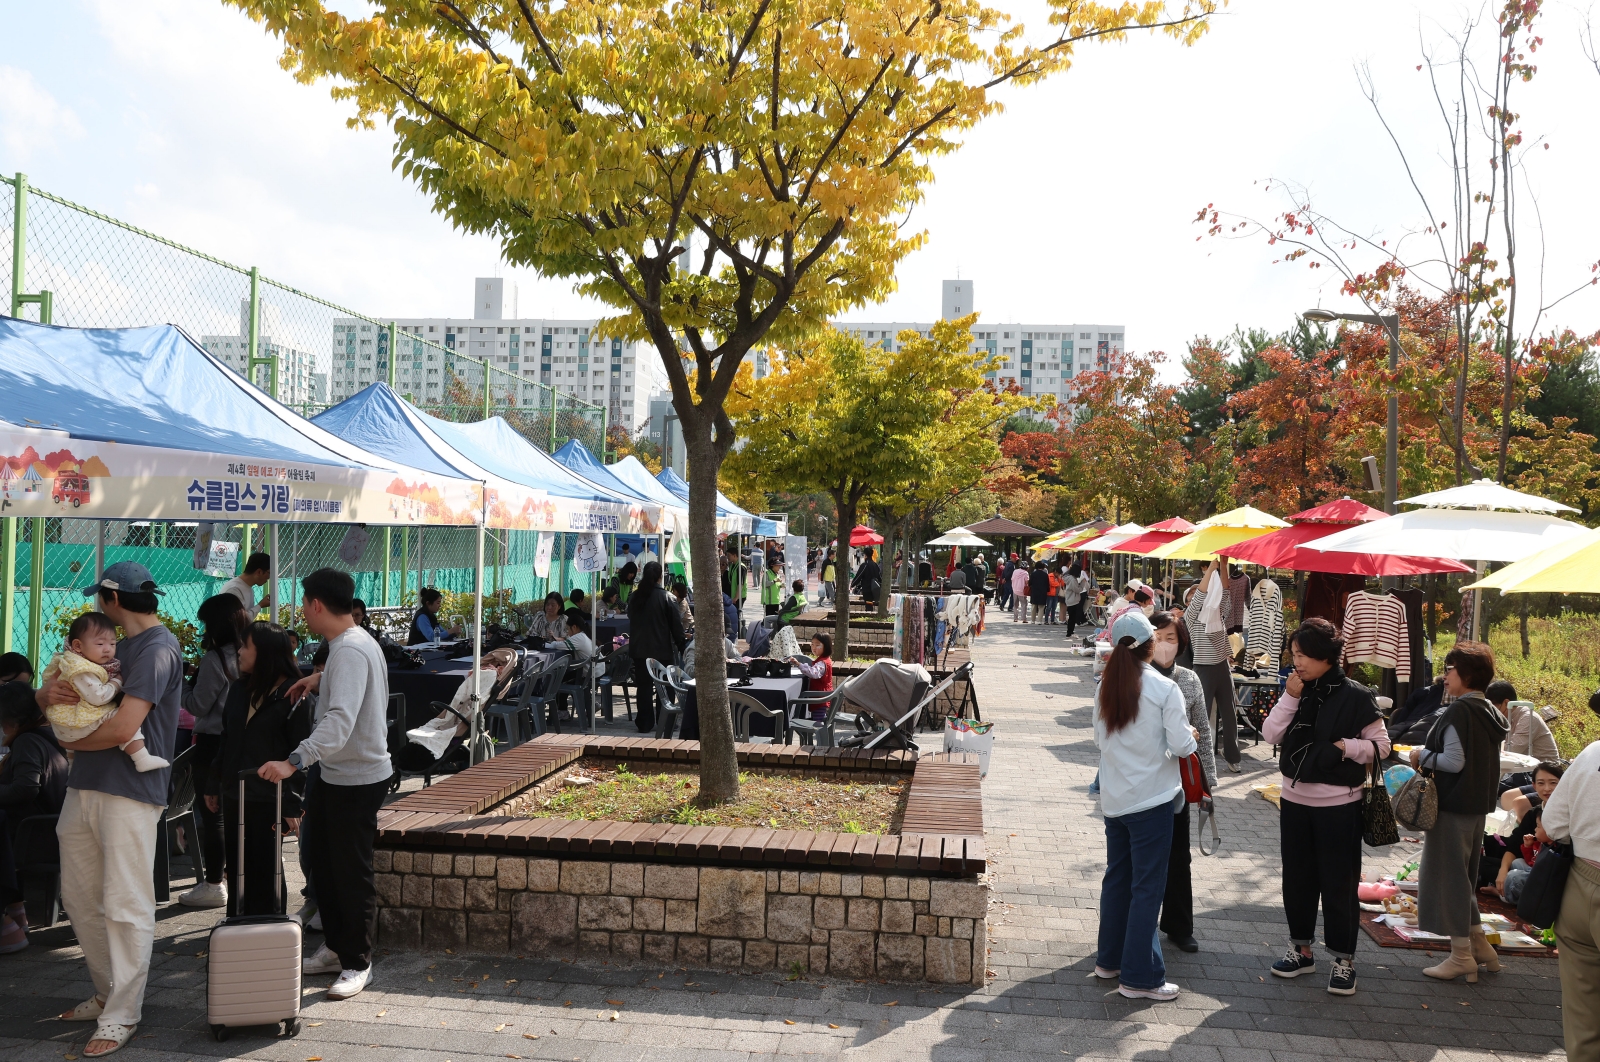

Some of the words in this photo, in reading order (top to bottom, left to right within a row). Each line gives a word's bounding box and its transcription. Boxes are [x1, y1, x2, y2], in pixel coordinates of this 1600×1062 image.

[227, 463, 246, 476] 제4회
[274, 467, 287, 479] 가족
[304, 469, 316, 482] 축제
[187, 479, 257, 512] 슈클링스
[261, 484, 290, 514] 키링
